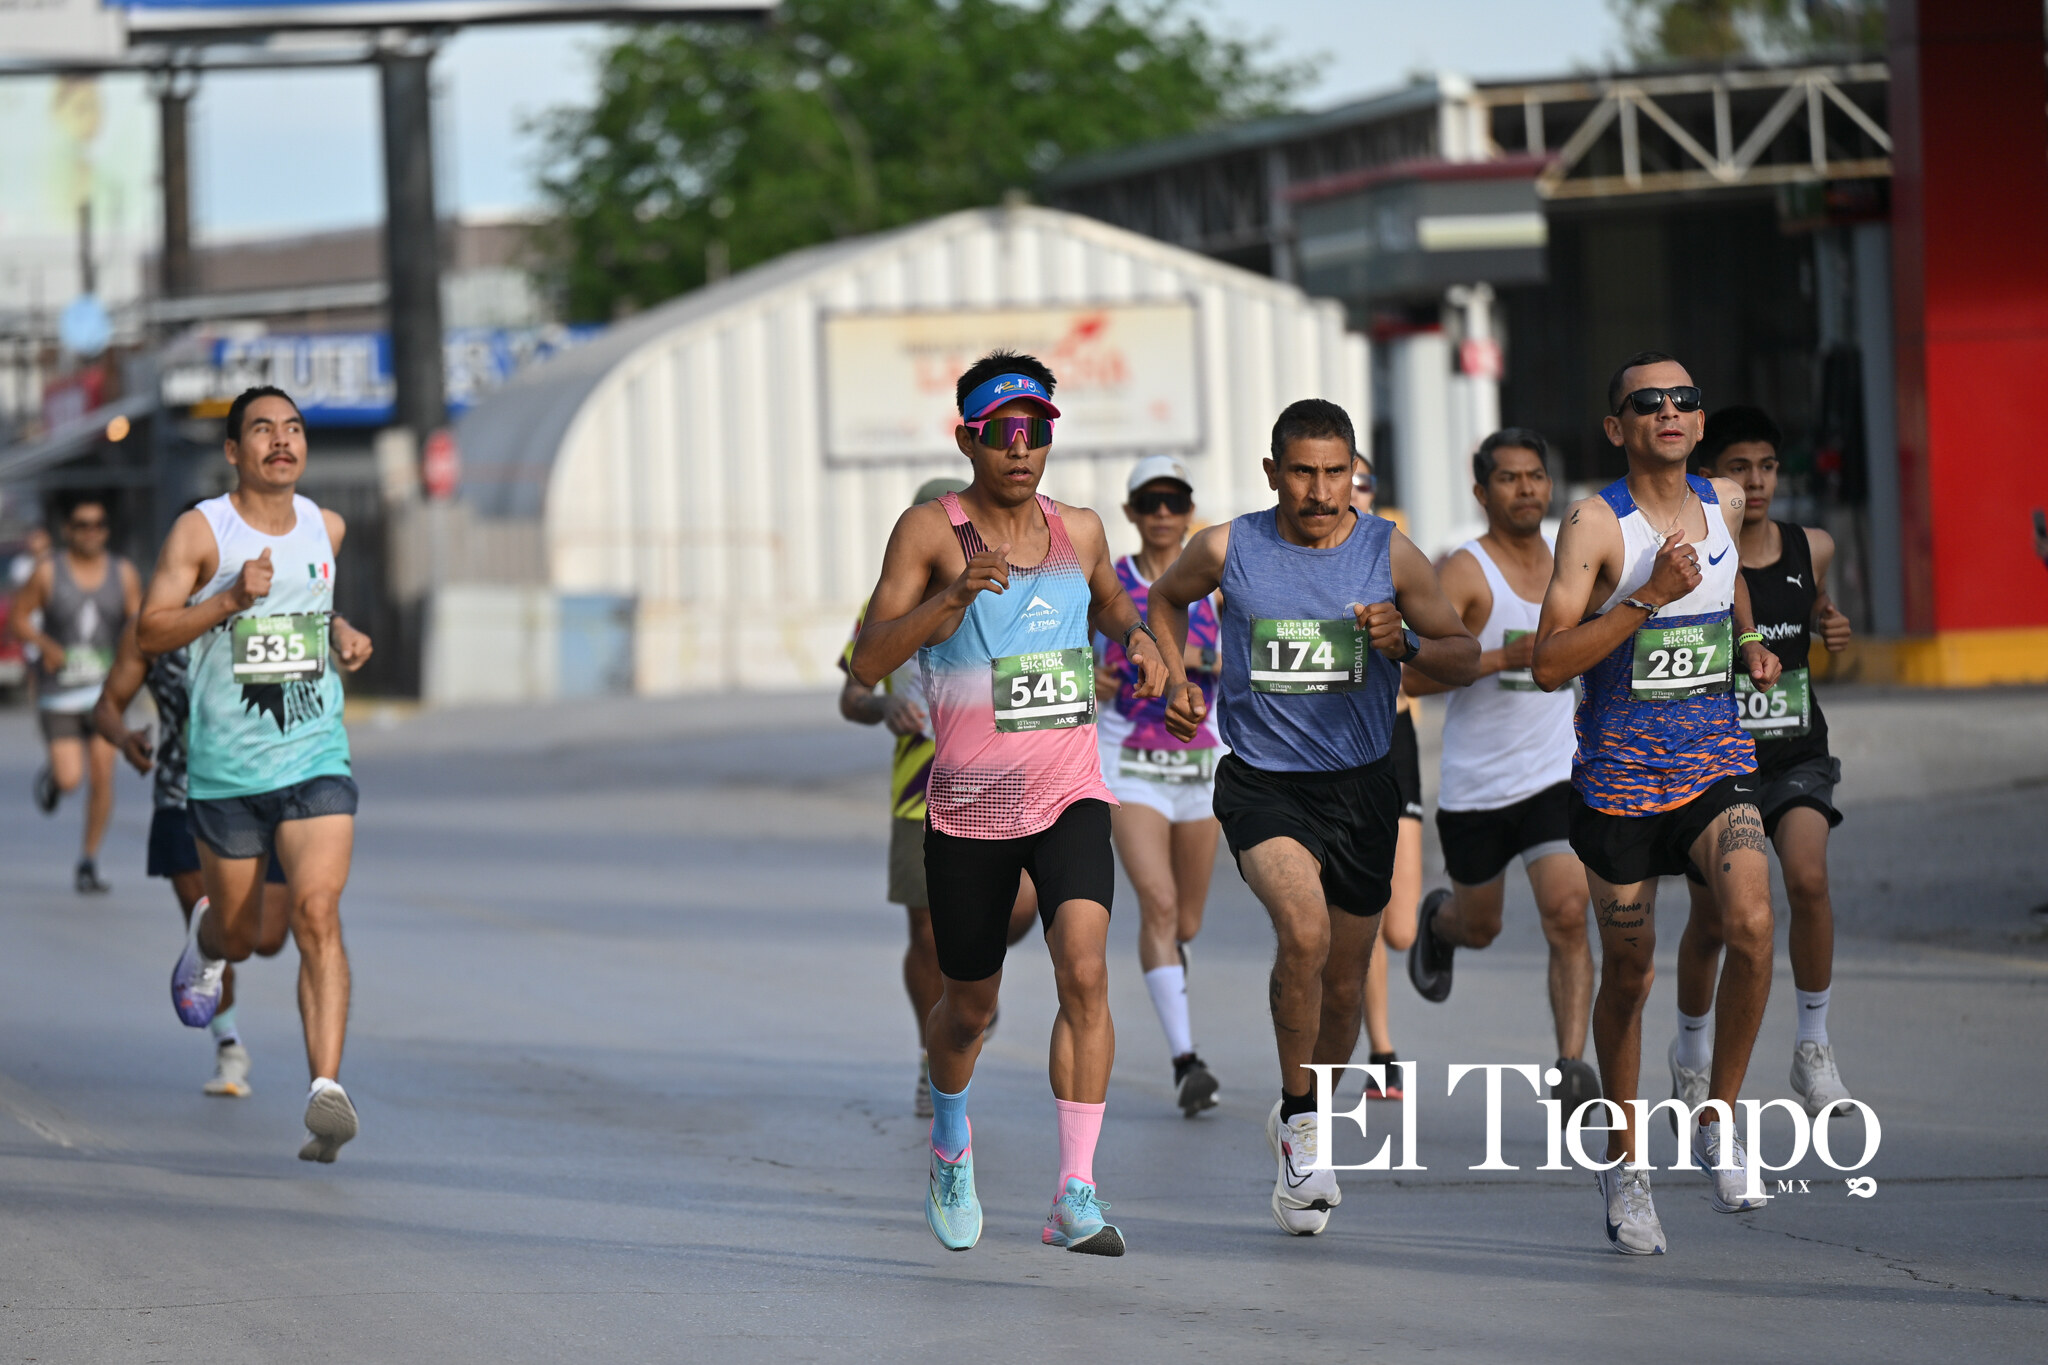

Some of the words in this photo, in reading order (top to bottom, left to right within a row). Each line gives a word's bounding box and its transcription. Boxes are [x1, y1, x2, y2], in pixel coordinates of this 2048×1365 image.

[246, 633, 305, 664] 535
[1663, 627, 1704, 637] CARRERA
[1020, 651, 1063, 662] CARRERA
[1266, 640, 1335, 670] 174
[1353, 636, 1364, 683] MEDALLA
[1647, 644, 1717, 679] 287
[1010, 670, 1078, 708] 545
[1086, 664, 1094, 715] MEDALLA
